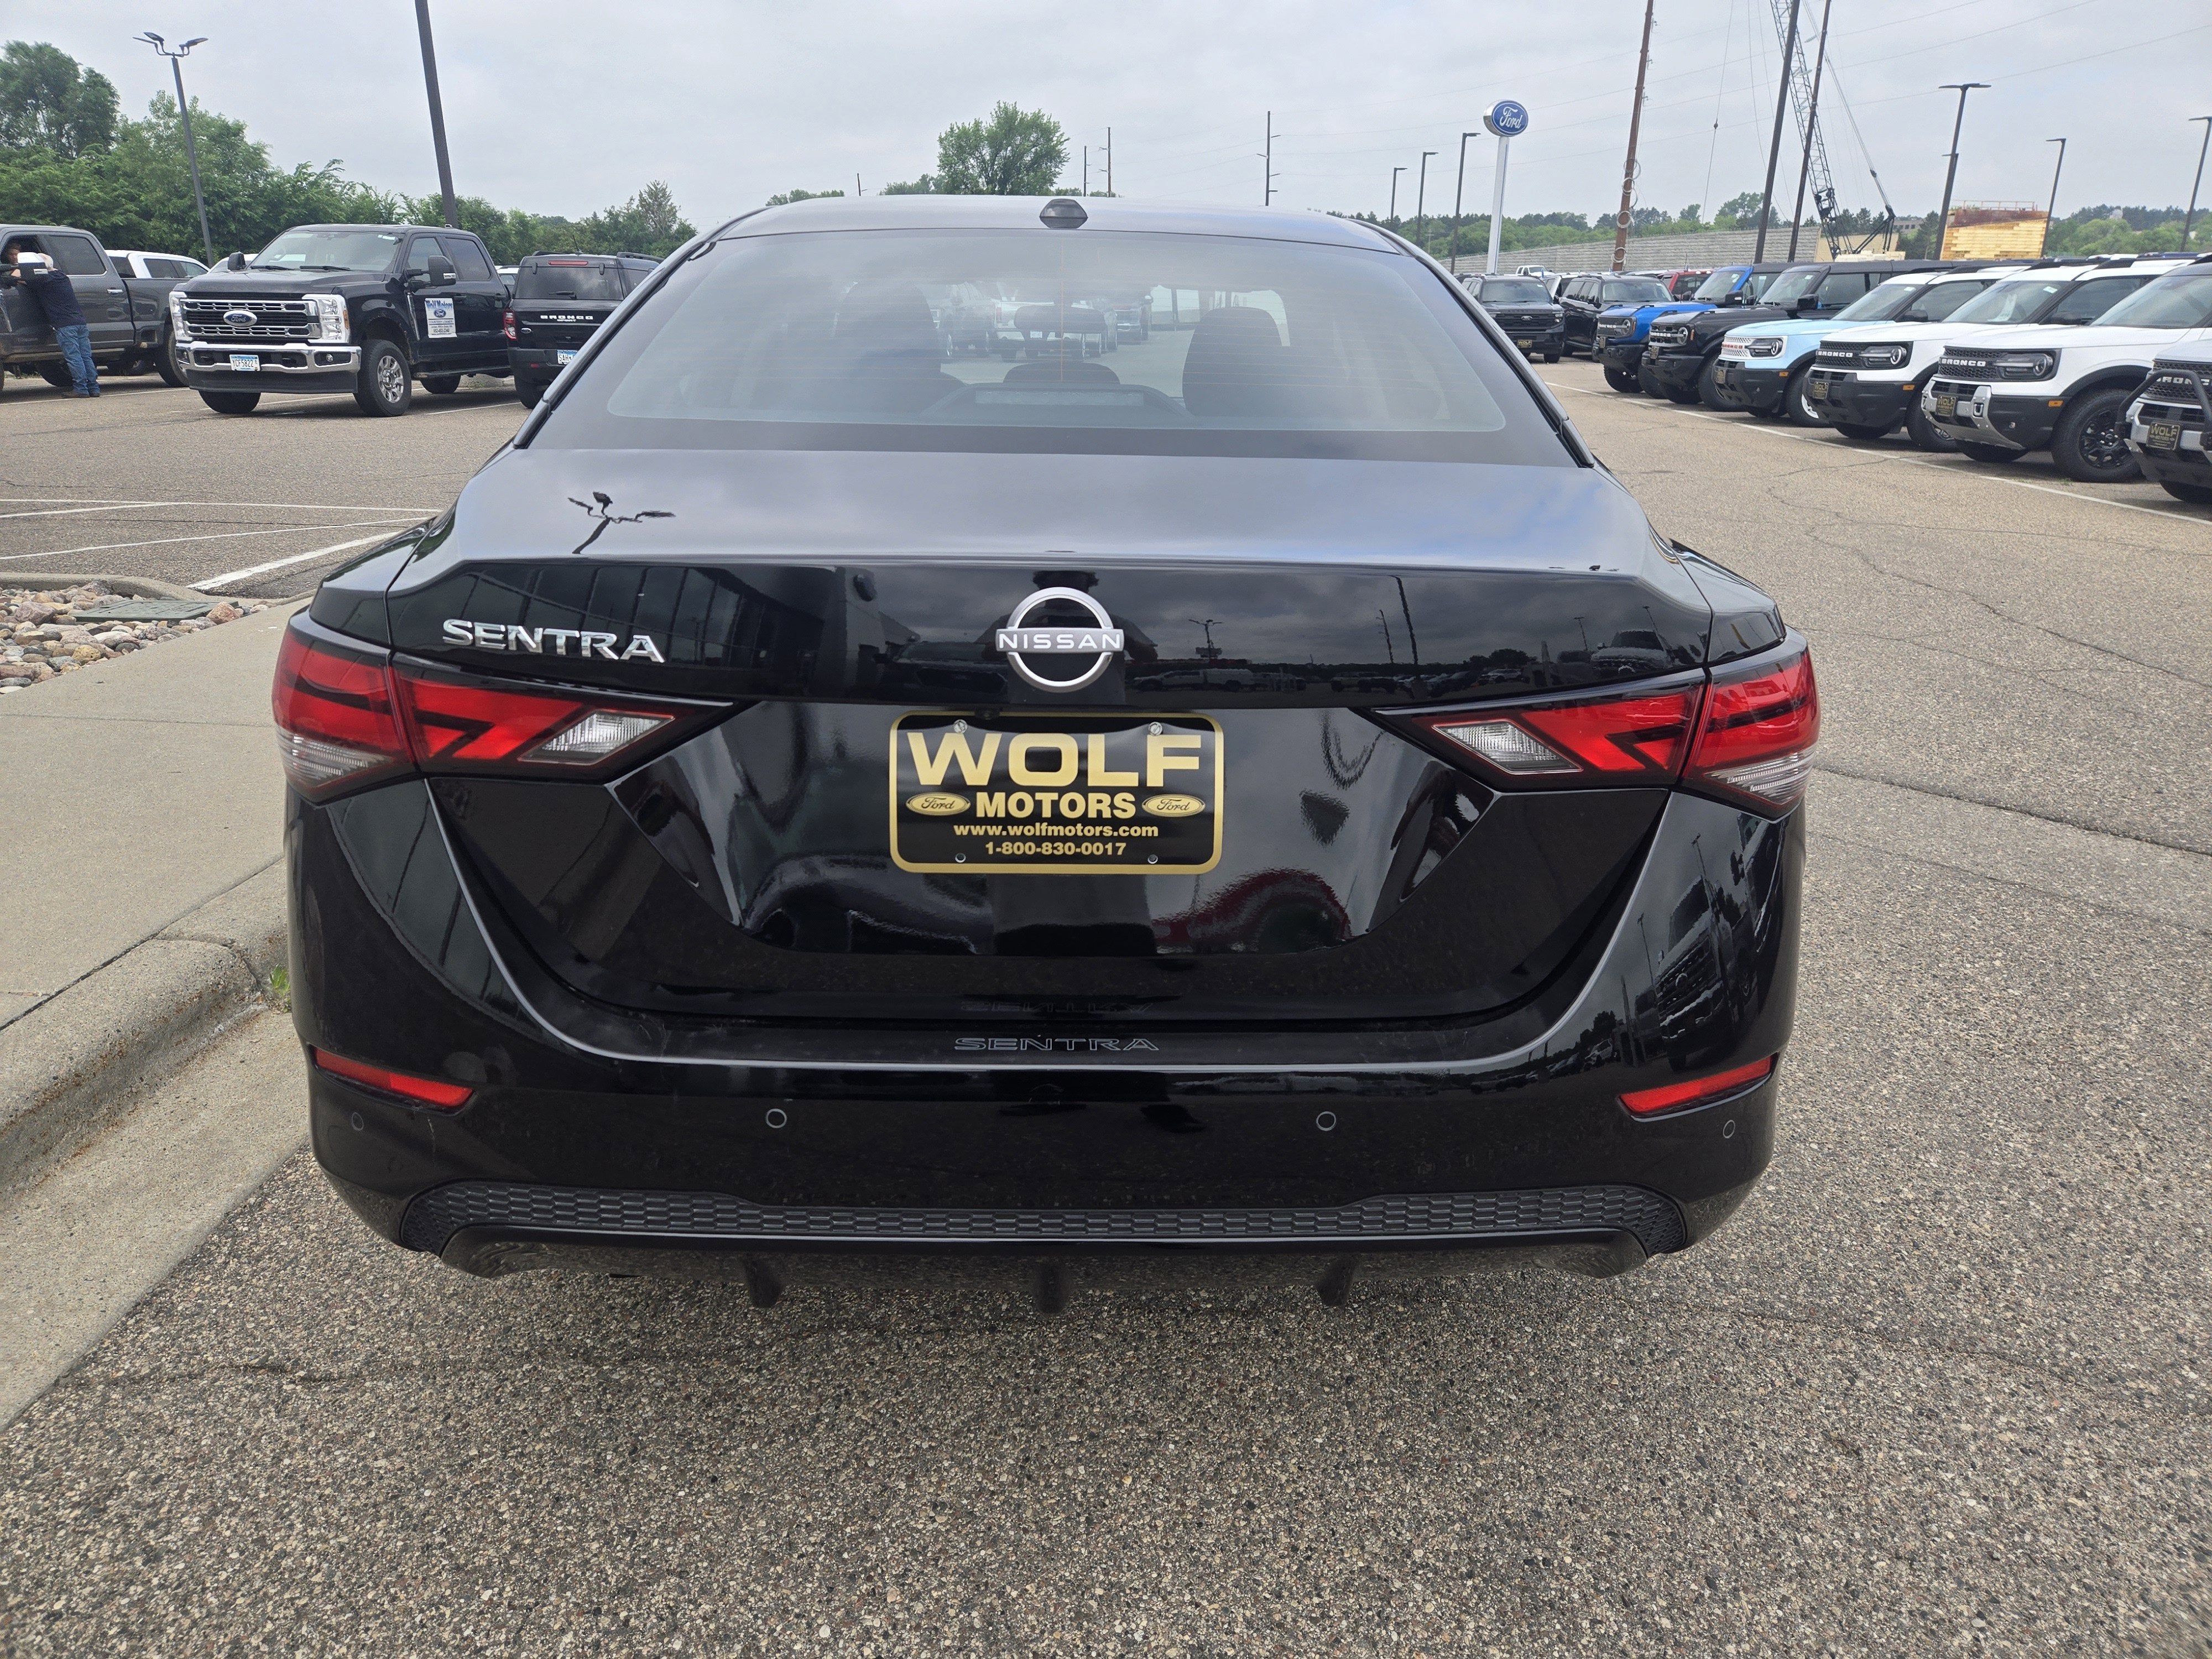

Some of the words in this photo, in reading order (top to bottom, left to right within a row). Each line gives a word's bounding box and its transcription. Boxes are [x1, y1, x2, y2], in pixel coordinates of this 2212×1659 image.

[1499, 106, 1523, 129] Ford
[1941, 358, 1986, 367] BRONCO
[2151, 426, 2177, 437] WOLF
[442, 619, 665, 663] SENTRA
[999, 634, 1120, 649] NISSAN
[907, 732, 1202, 787] WOLF
[921, 796, 955, 810] Ford
[975, 792, 1136, 818] MOTORS
[1156, 797, 1191, 811] Ford
[953, 822, 1159, 837] www.wolfmotors.com
[985, 842, 1126, 855] 1-800-830-0017
[954, 1037, 1160, 1051] SENTRA
